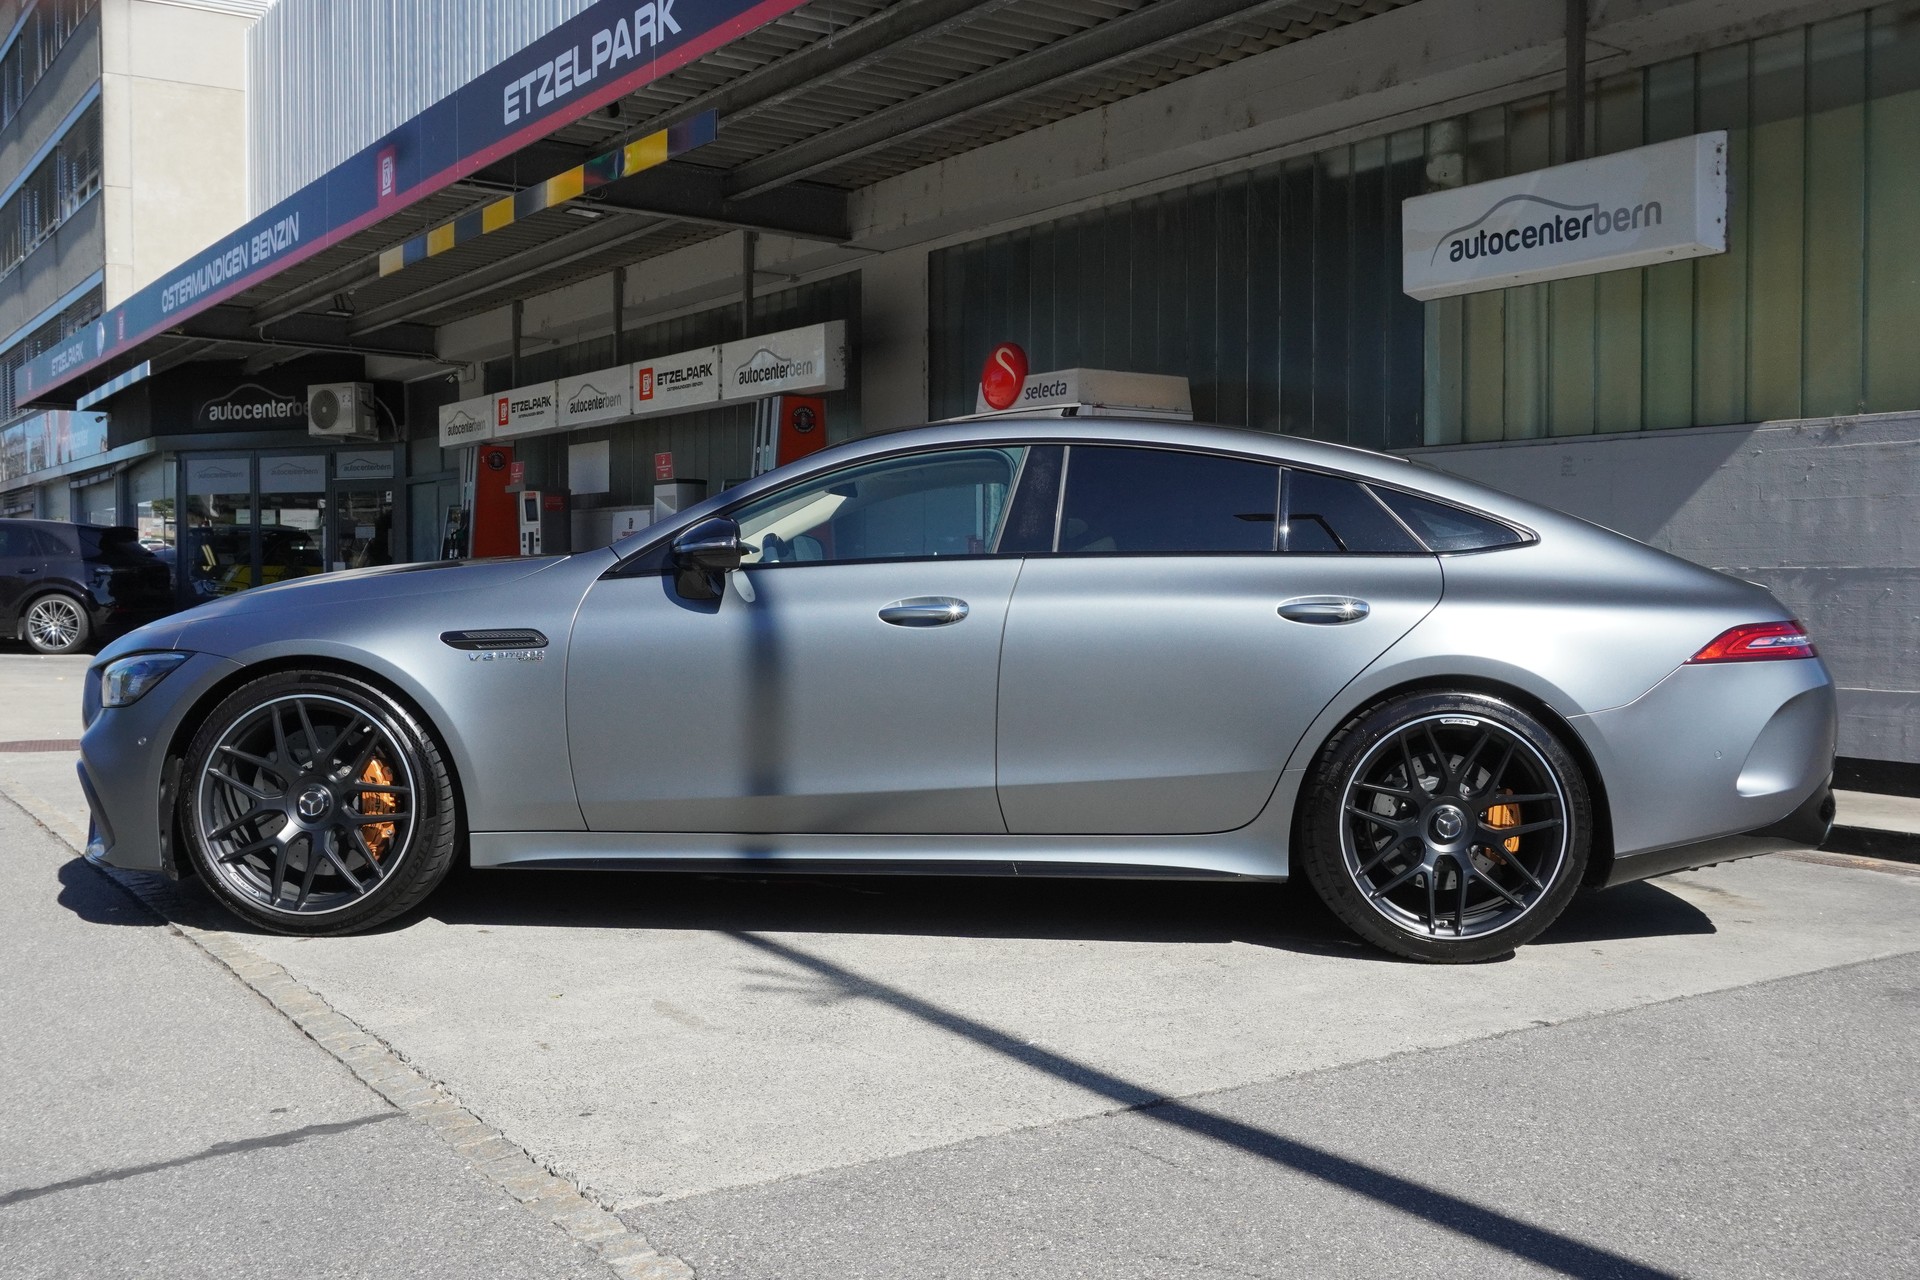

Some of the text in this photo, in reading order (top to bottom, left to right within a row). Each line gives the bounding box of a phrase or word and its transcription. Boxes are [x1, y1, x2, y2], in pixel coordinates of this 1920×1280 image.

[504, 0, 682, 126] ETZELPARK
[1449, 202, 1662, 263] autocenterbern
[161, 211, 299, 313] OSTERMUNDIGEN BENZIN
[657, 362, 713, 386] ETZELPARK
[738, 359, 813, 385] autocenterbern
[1024, 380, 1067, 401] selecta
[511, 395, 552, 414] ETZELPARK
[569, 394, 622, 414] autocenterbern
[447, 418, 486, 436] autocenterbern
